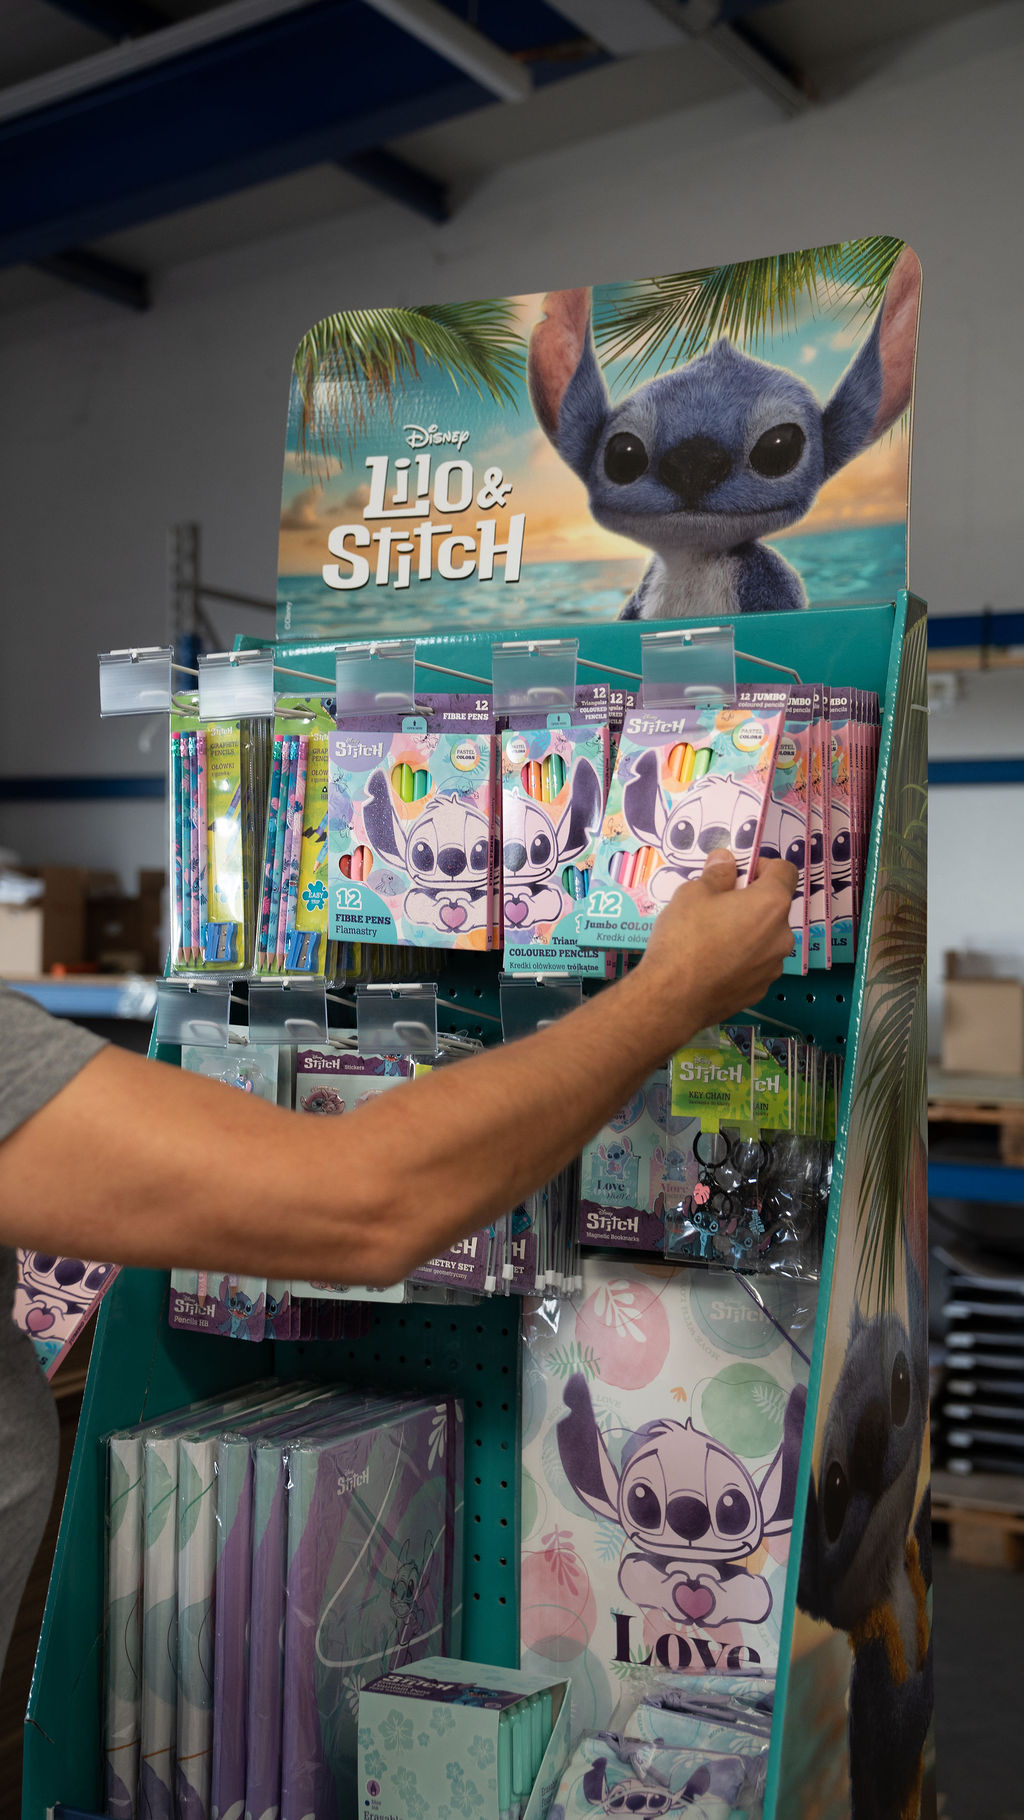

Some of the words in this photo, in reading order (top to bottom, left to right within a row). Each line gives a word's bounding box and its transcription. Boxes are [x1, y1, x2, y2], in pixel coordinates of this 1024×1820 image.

[403, 424, 469, 451] Disney
[477, 467, 513, 510] &
[593, 687, 606, 698] 12
[752, 692, 786, 701] JUMBO
[610, 693, 623, 704] 12
[787, 697, 811, 706] UMBO
[475, 700, 489, 711] 12
[580, 706, 607, 714] COLOURED
[442, 713, 466, 721] FIBRE
[467, 713, 489, 721] PENS
[336, 887, 362, 911] 12
[586, 890, 624, 918] 12
[335, 914, 362, 924] FIBRE
[365, 915, 391, 925] PENS
[584, 920, 618, 930] Jumbo
[335, 926, 378, 937] Flamastry
[597, 932, 625, 942] Kredki
[509, 948, 557, 957] COLOURED
[559, 949, 599, 958] PENCILS
[509, 962, 531, 970] Kredki
[567, 963, 599, 973] trójkątne
[688, 1091, 704, 1099] KEY
[705, 1092, 731, 1101] CHAIN
[597, 1180, 625, 1192] Love
[586, 1232, 610, 1241] Magnetic
[610, 1233, 640, 1243] Bookmarks
[457, 1263, 475, 1274] SET
[174, 1315, 198, 1326] Pencils
[199, 1320, 209, 1328] HB
[611, 1612, 761, 1671] Love
